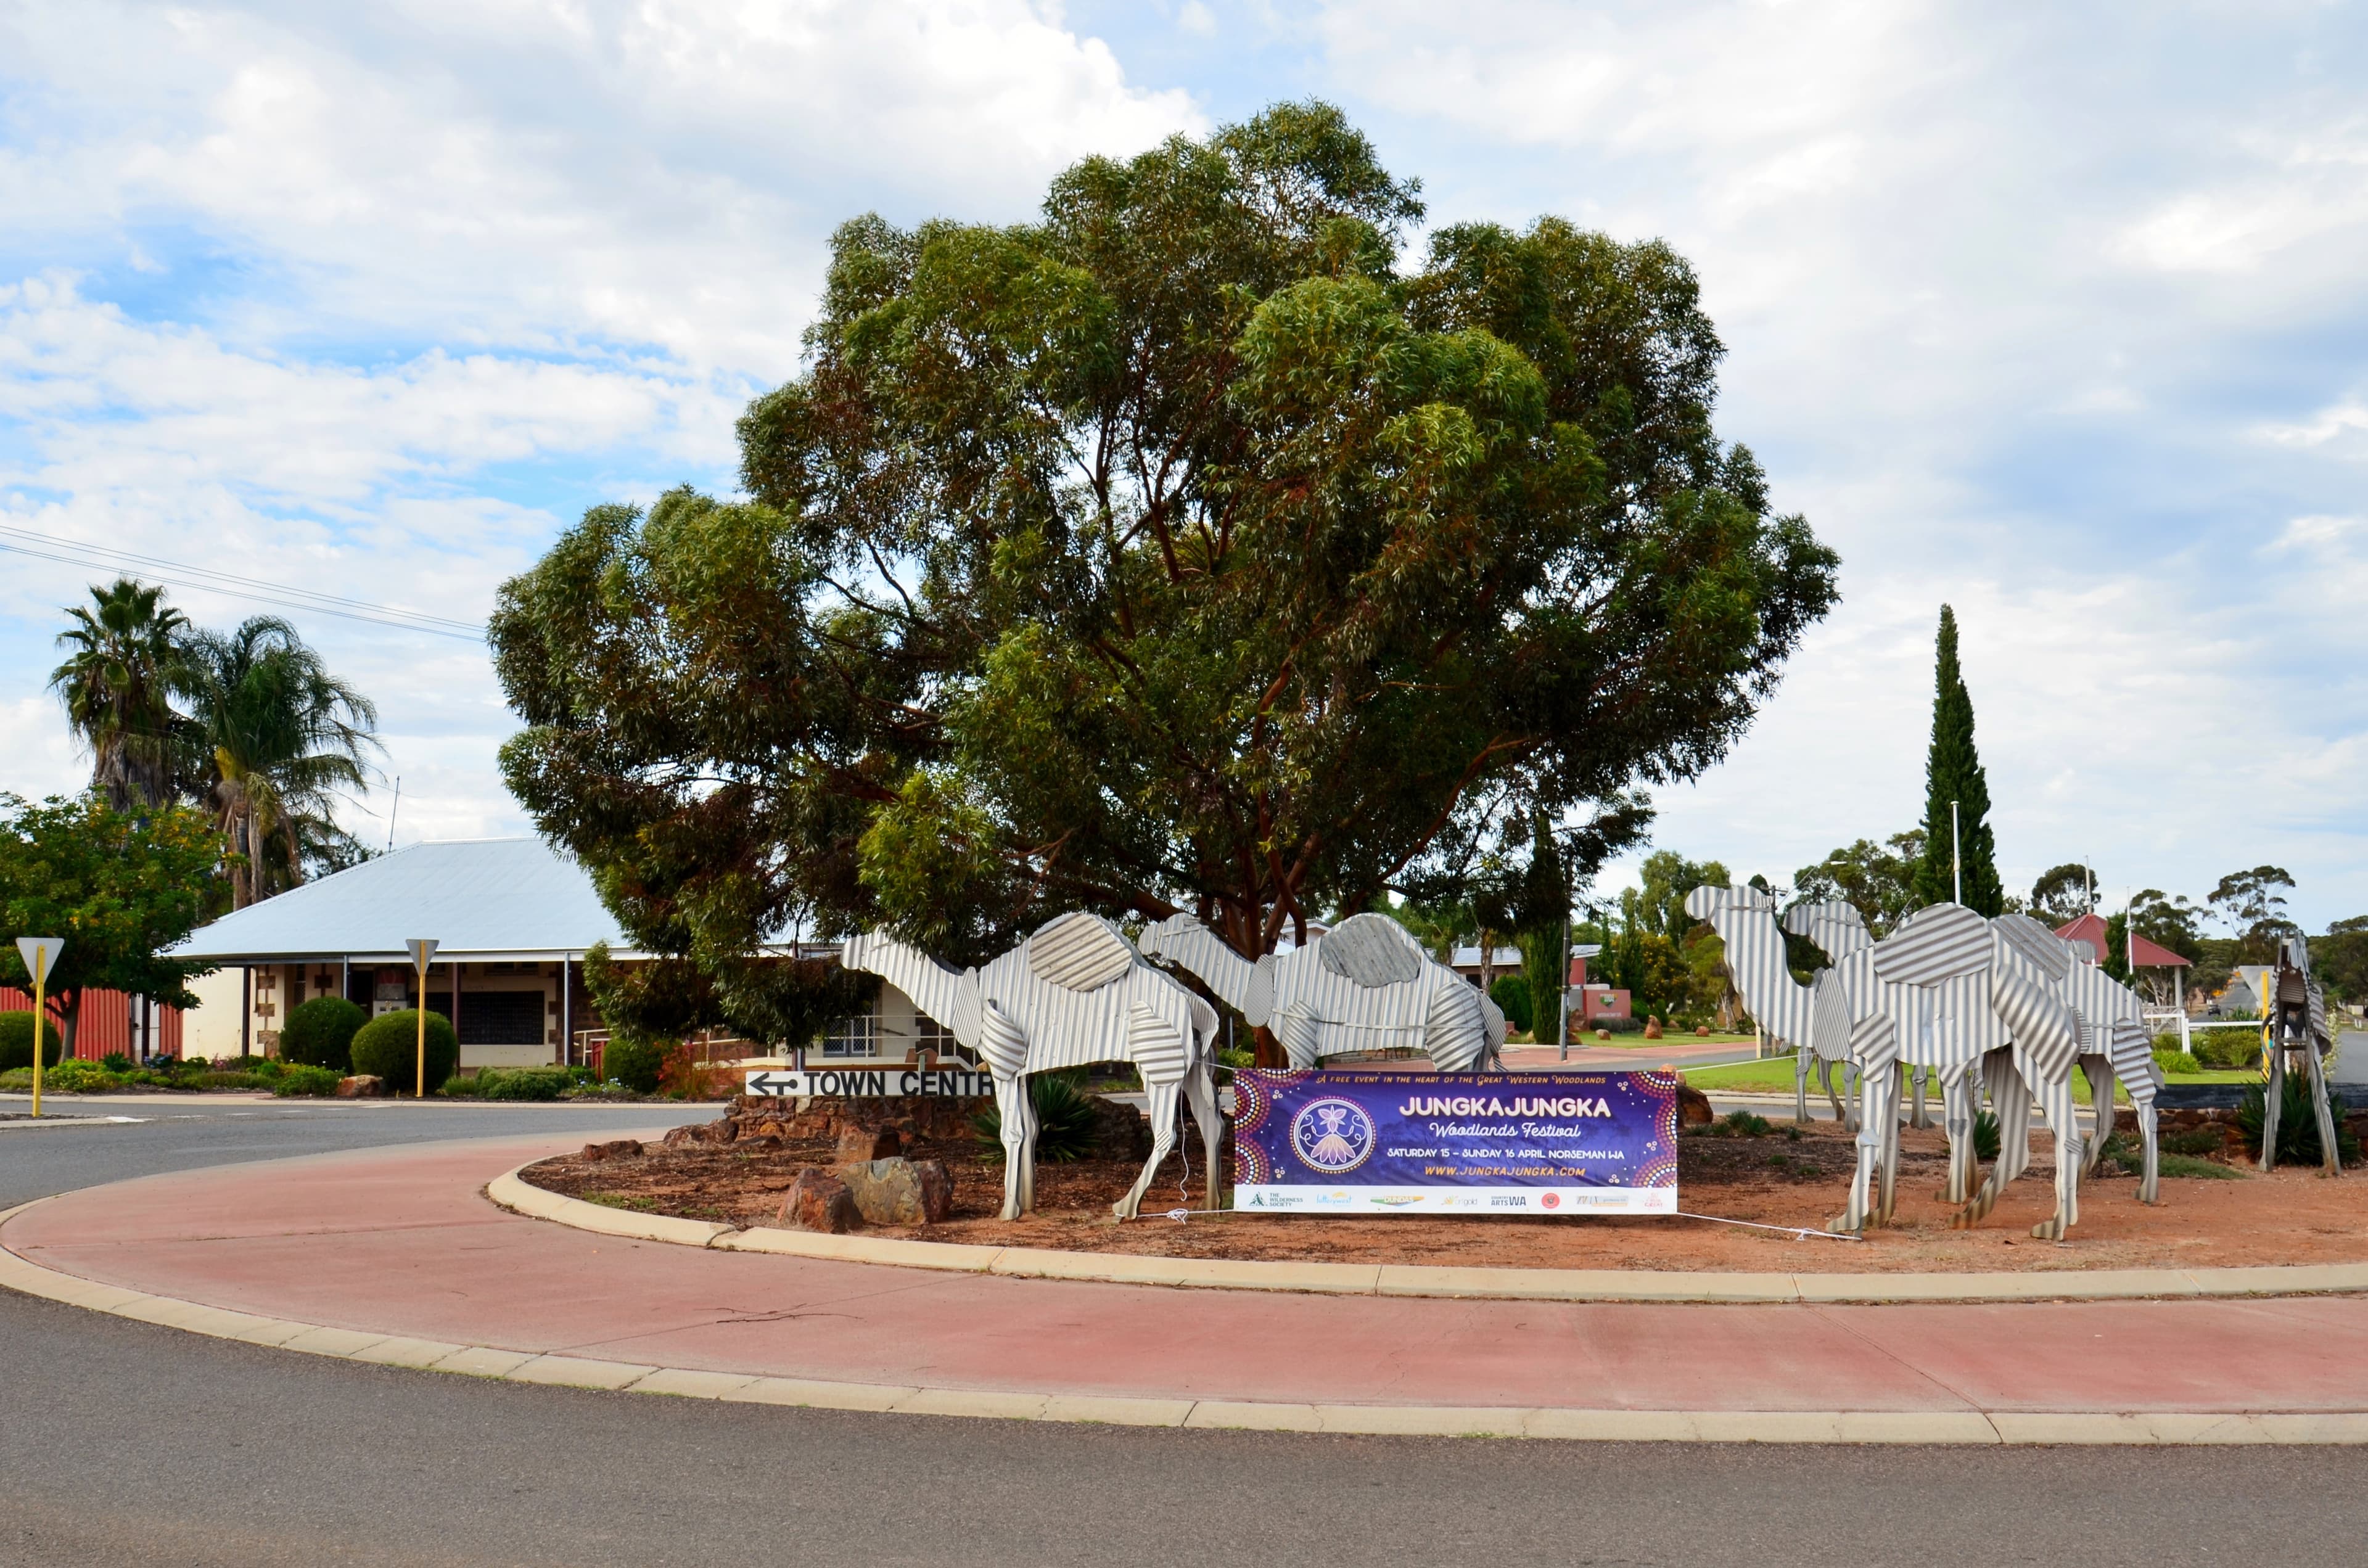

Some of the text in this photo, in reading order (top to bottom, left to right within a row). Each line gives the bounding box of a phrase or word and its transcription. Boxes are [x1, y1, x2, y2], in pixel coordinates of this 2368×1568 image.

[804, 1072, 996, 1096] TOWN CENTR
[1316, 1075, 1326, 1084] A
[1399, 1096, 1611, 1117] JUNGKAJUNGKA
[1429, 1122, 1581, 1138] Woodlands Festival
[1387, 1147, 1437, 1157] SATURDAY
[1440, 1147, 1450, 1157] 15
[1462, 1148, 1502, 1158] SUNDAY
[1505, 1149, 1515, 1158] 16
[1518, 1149, 1546, 1159] APRIL
[1548, 1150, 1606, 1159] NORSEMAN
[1608, 1151, 1624, 1159] WA
[1424, 1166, 1585, 1177] WWW.JUNGKAJUNGKA.COM
[1509, 1196, 1526, 1205] WA
